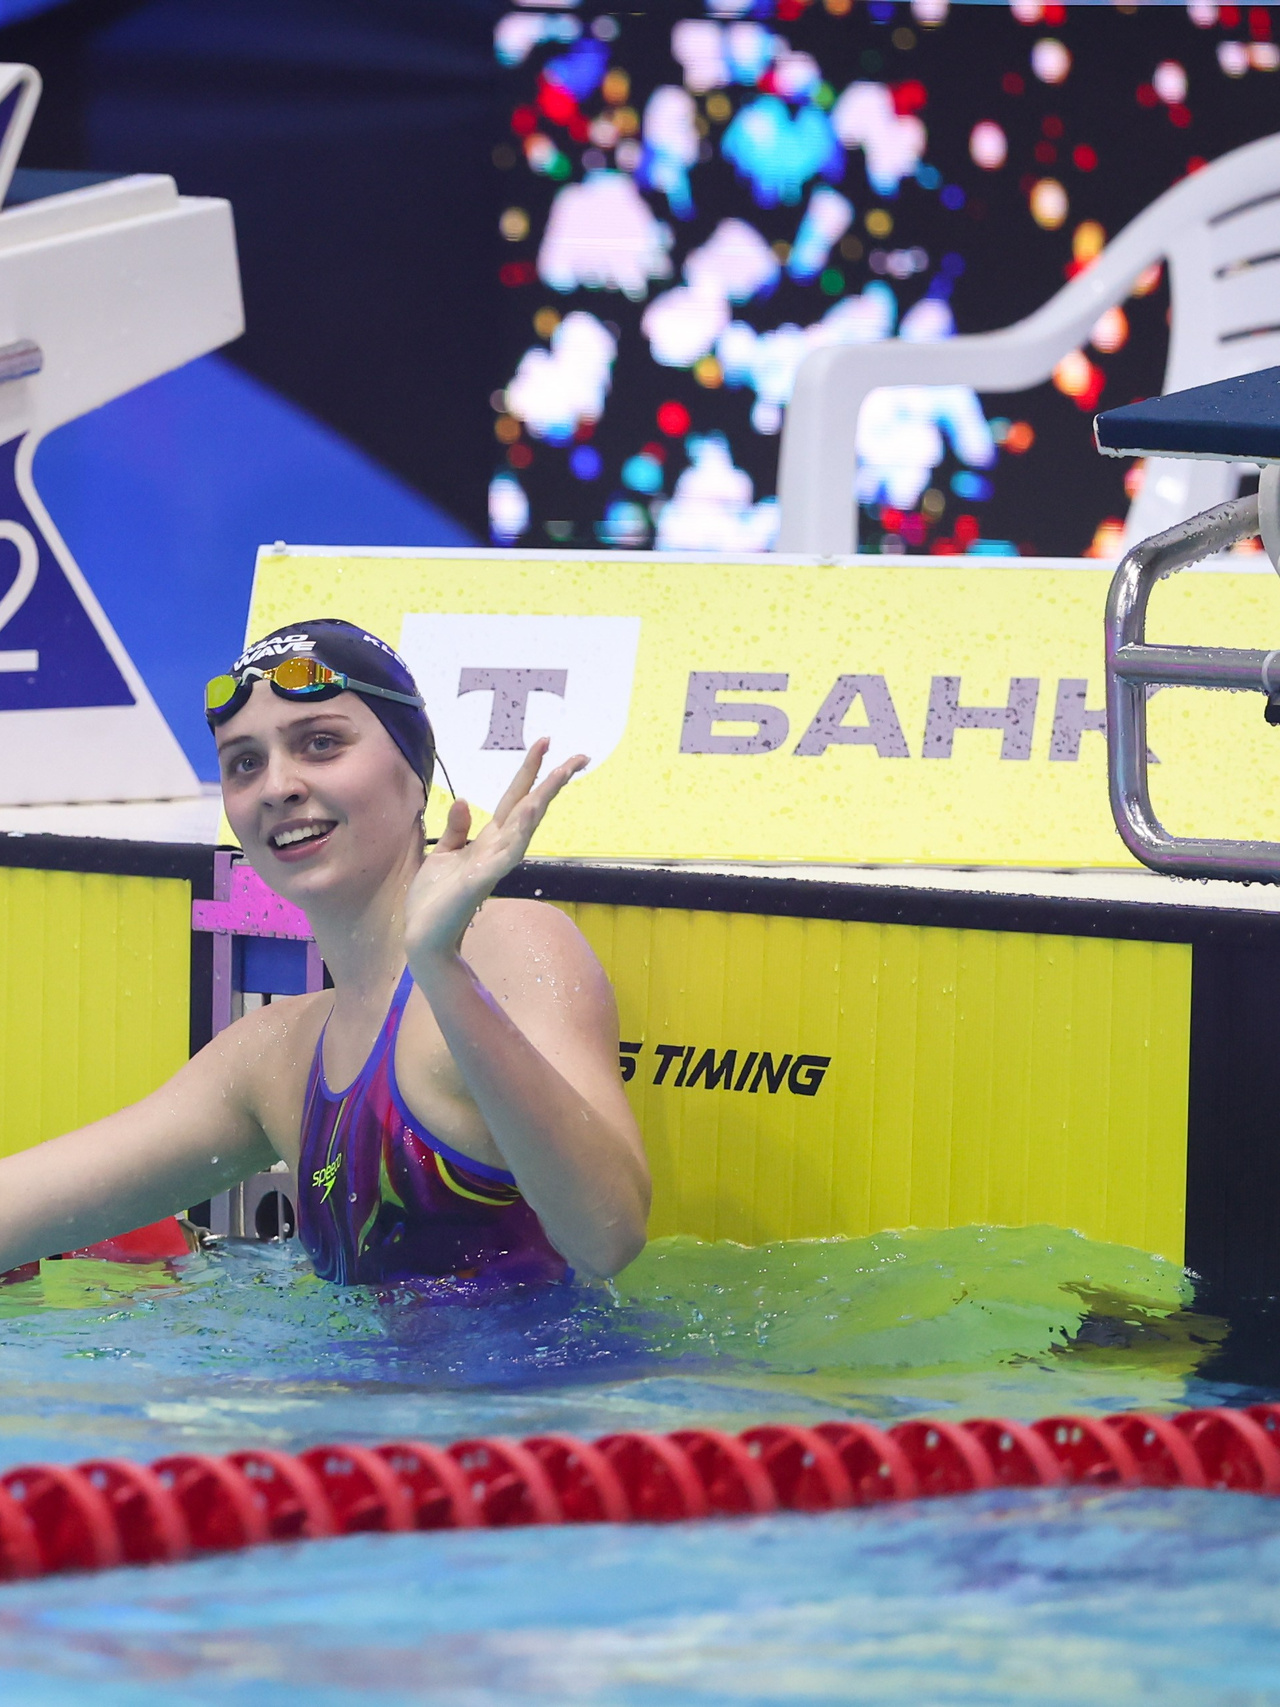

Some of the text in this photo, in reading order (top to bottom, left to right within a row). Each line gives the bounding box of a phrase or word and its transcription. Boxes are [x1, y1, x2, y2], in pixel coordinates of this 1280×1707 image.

[233, 641, 316, 672] WAVE
[457, 666, 568, 751] Т
[652, 1043, 832, 1097] TIMING
[311, 1152, 342, 1187] speedo
